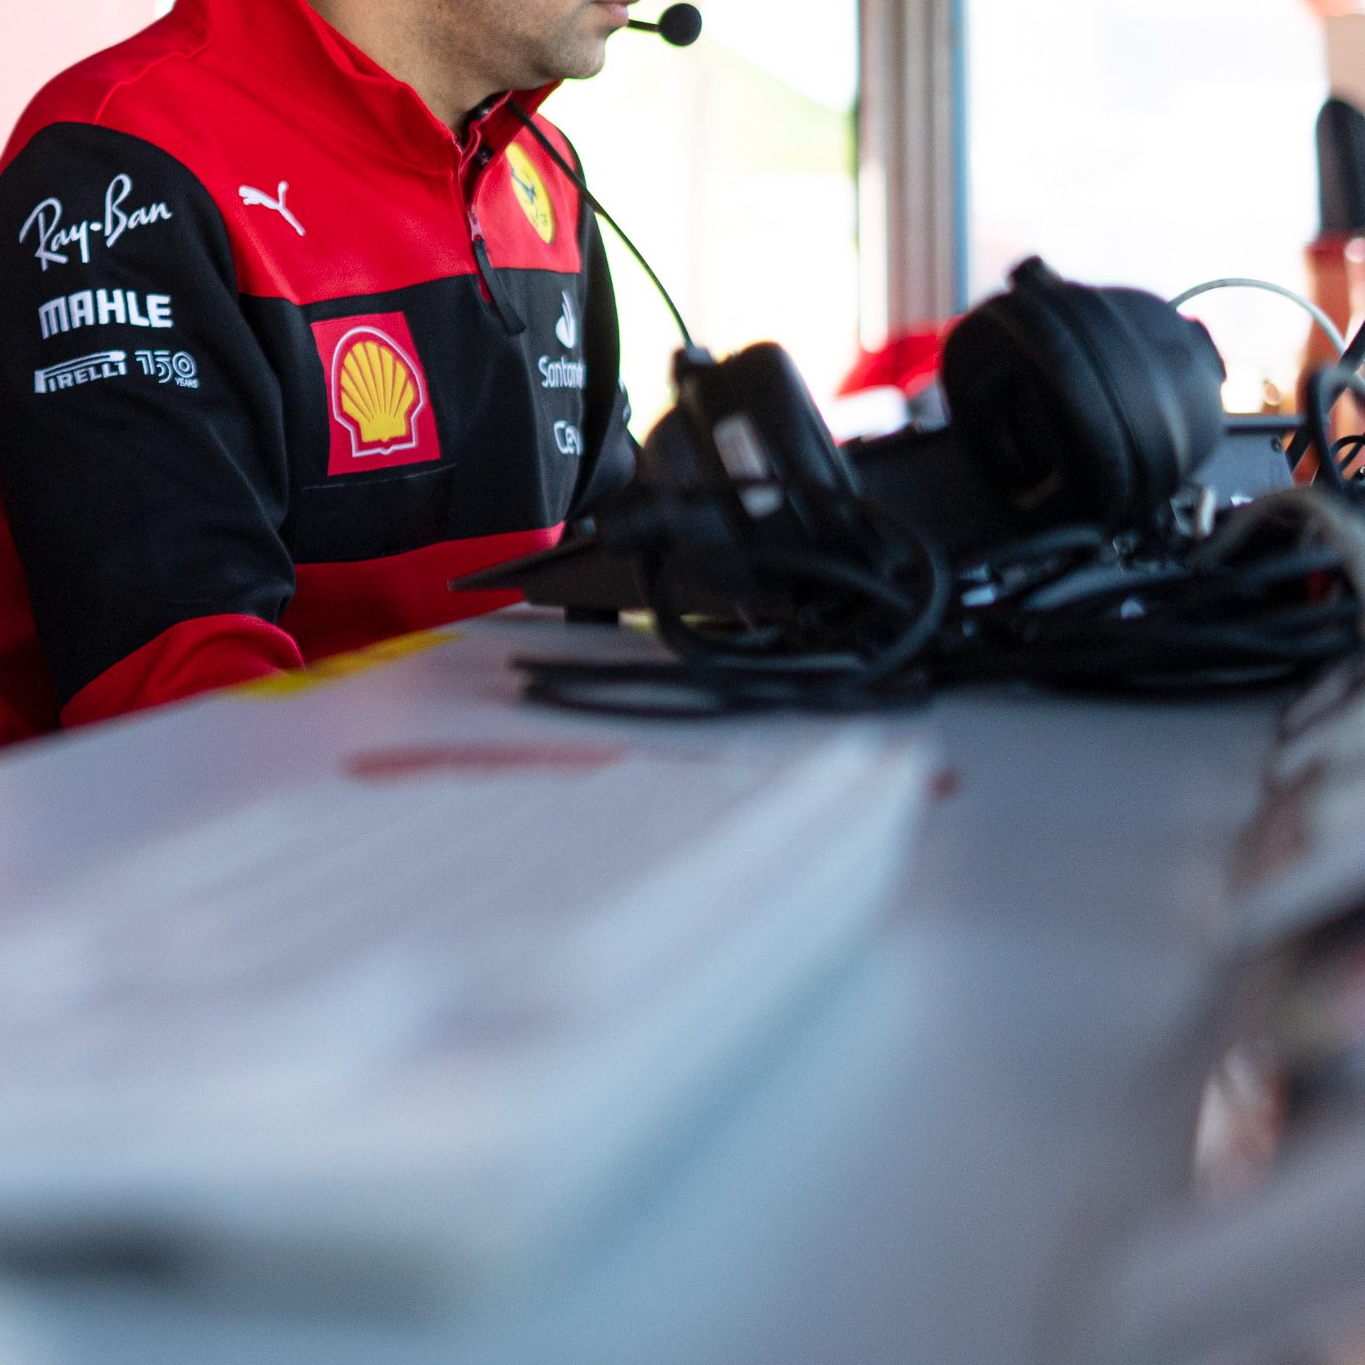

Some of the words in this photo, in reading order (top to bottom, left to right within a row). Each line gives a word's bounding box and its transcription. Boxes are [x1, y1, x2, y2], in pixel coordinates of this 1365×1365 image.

[19, 173, 172, 272] Ray-Ban
[38, 289, 174, 339] MAHLE
[34, 350, 127, 394] PIRELLI
